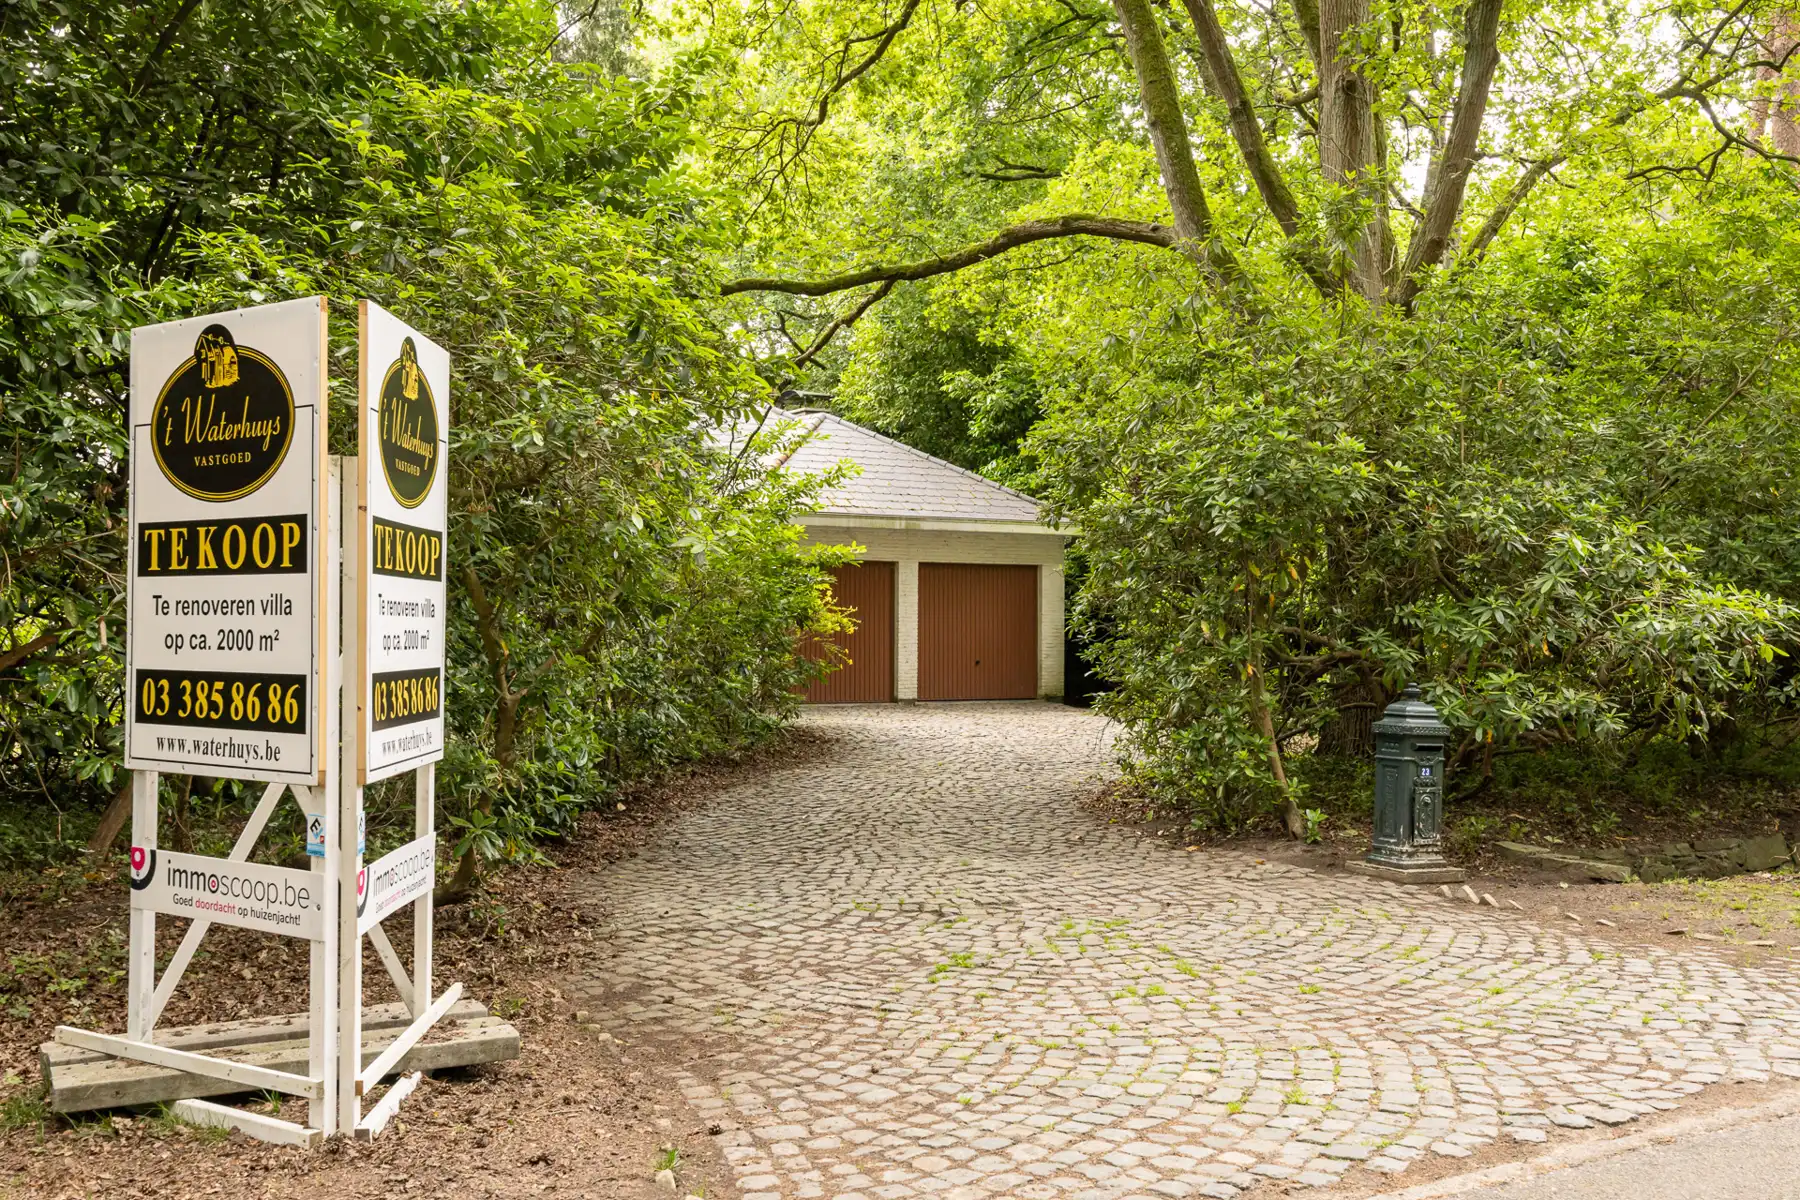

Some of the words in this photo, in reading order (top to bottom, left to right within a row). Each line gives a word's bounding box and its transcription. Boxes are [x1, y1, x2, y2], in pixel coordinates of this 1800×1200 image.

[163, 405, 172, 447] 't
[181, 394, 281, 452] Waterhuys
[391, 397, 434, 471] Waterhuys
[194, 452, 252, 467] VASTGOED
[395, 458, 421, 477] VASTGOED
[152, 595, 170, 616] Te
[175, 597, 255, 617] renoveren
[260, 593, 293, 617] villa
[378, 593, 385, 616] Te
[387, 600, 419, 618] renoveren
[421, 598, 435, 618] villa
[164, 633, 184, 655] op
[189, 631, 211, 651] ca.
[217, 629, 254, 651] 2000
[259, 629, 279, 652] m²
[383, 634, 391, 656] op
[393, 633, 402, 651] ca.
[404, 630, 418, 650] 2000
[142, 677, 170, 717] 03
[177, 680, 224, 720] 385
[267, 683, 301, 724] 86
[374, 682, 387, 722] 03
[156, 735, 281, 764] www.waterhuys.be
[382, 727, 433, 758] www.waterhuys.be
[167, 859, 310, 910] immoscoop.be
[374, 848, 431, 898] immoscoop.be
[173, 893, 193, 907] Goed
[195, 898, 236, 914] doordacht
[238, 907, 248, 918] op
[250, 906, 301, 926] huizenjacht!
